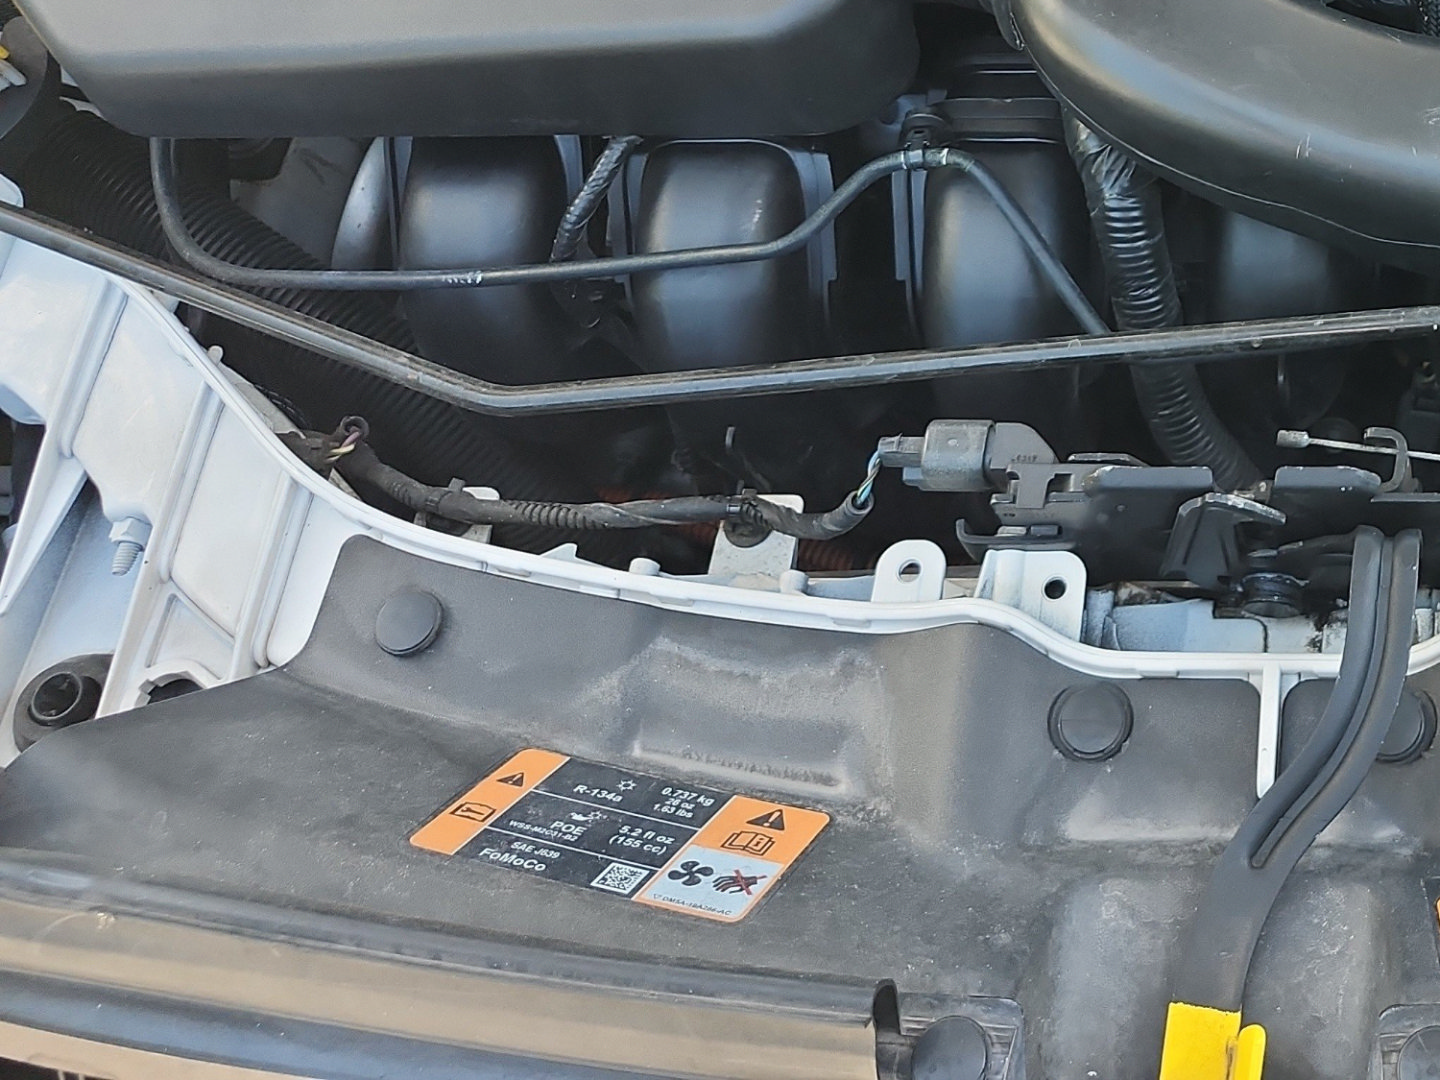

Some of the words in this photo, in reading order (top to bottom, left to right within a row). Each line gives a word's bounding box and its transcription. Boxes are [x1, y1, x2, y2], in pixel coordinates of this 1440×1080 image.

[573, 785, 623, 802] R-134a
[661, 787, 698, 800] 0.737
[697, 795, 715, 806] kg
[665, 798, 681, 806] 26
[653, 804, 676, 813] 1.63
[675, 809, 693, 818] lbs
[550, 821, 587, 835] POE
[619, 825, 642, 836] 5.2
[643, 831, 656, 839] fl
[656, 836, 675, 844] oz
[511, 842, 535, 852] SAE
[609, 835, 643, 848] (155
[643, 844, 667, 855] cc)
[478, 848, 546, 871] FoMoCo
